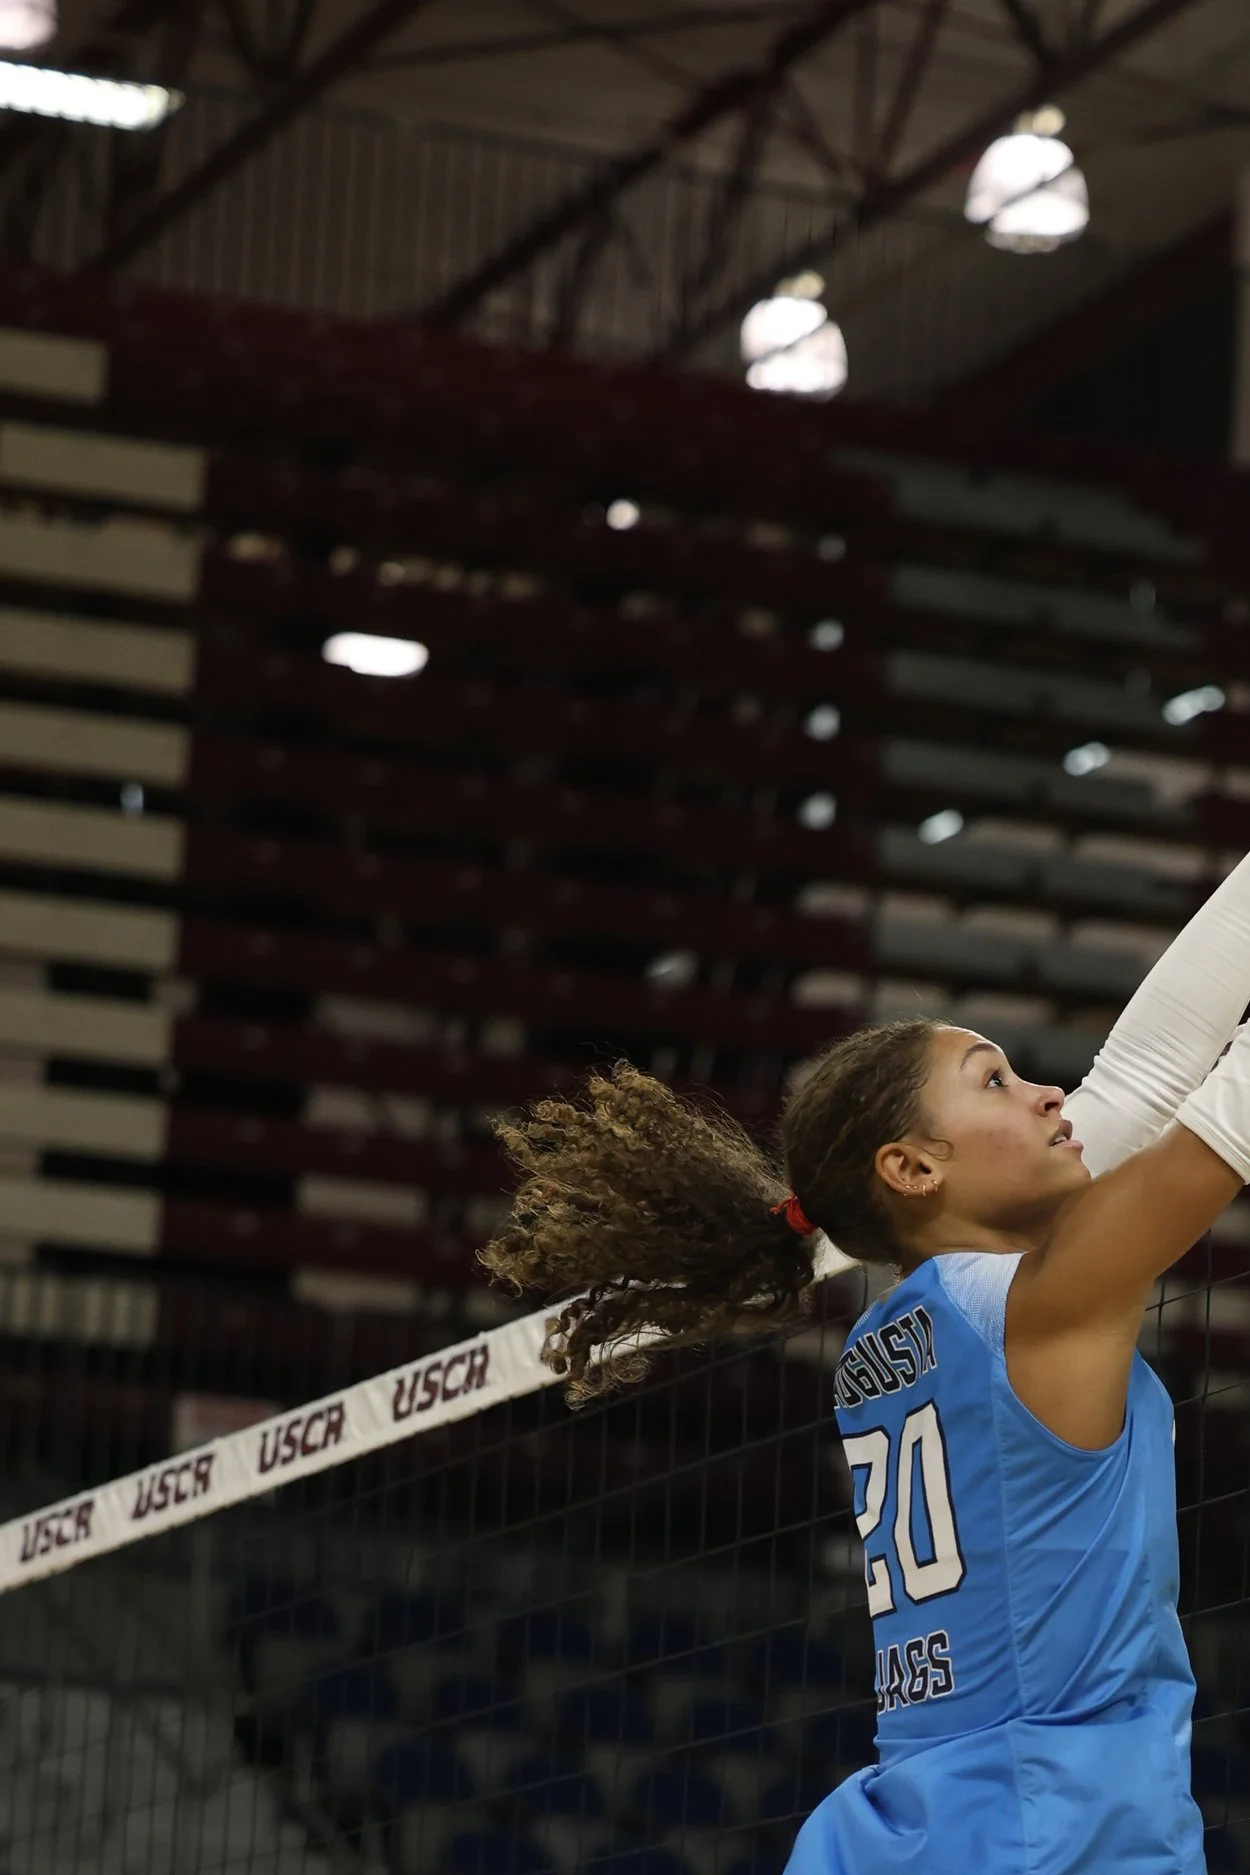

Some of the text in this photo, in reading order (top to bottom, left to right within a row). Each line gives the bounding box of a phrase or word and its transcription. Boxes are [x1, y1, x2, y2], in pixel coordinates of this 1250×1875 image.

[19, 1345, 490, 1562] USCA USCA USCA USCA
[834, 1304, 938, 1409] UGUSTA
[842, 1399, 967, 1619] 20
